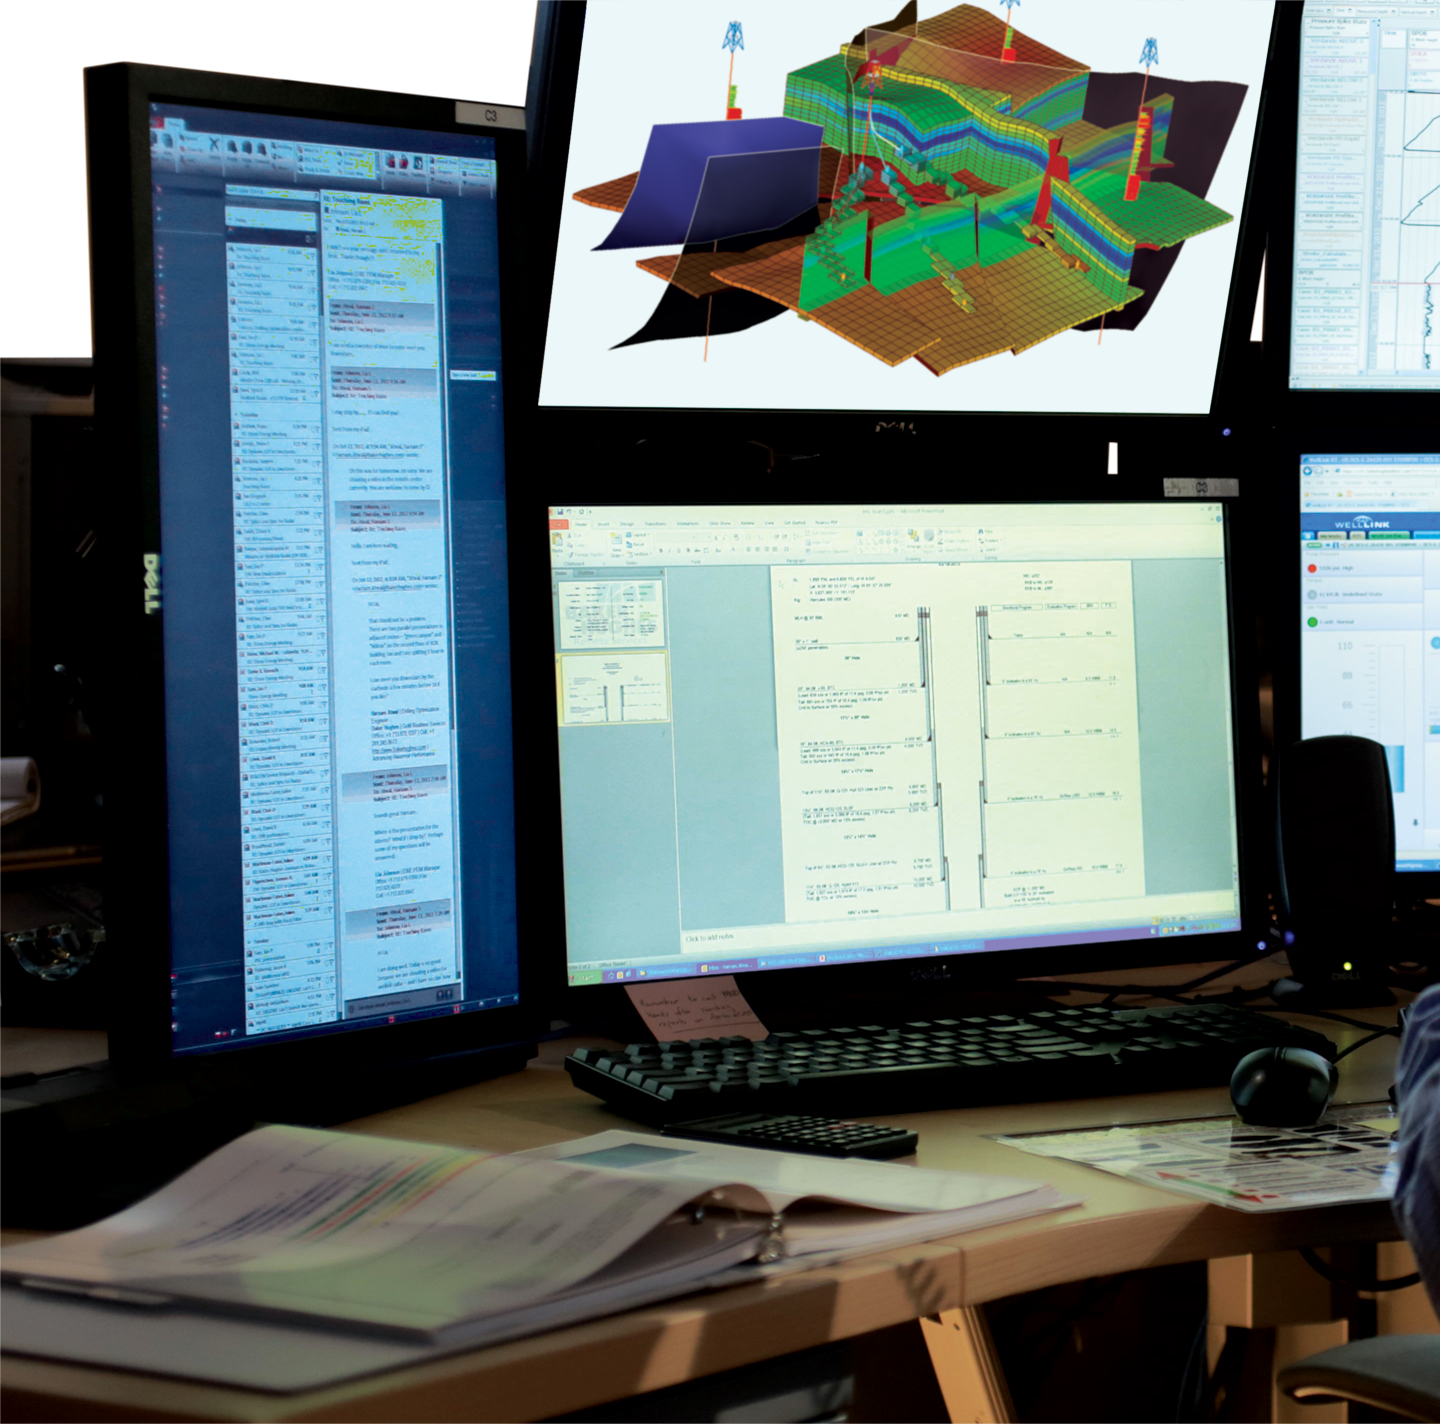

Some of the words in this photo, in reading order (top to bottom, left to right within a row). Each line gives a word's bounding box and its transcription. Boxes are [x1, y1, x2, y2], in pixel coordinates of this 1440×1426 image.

[485, 109, 497, 122] C3
[1338, 642, 1353, 650] 110
[1342, 672, 1353, 680] 88
[1342, 701, 1353, 709] 66
